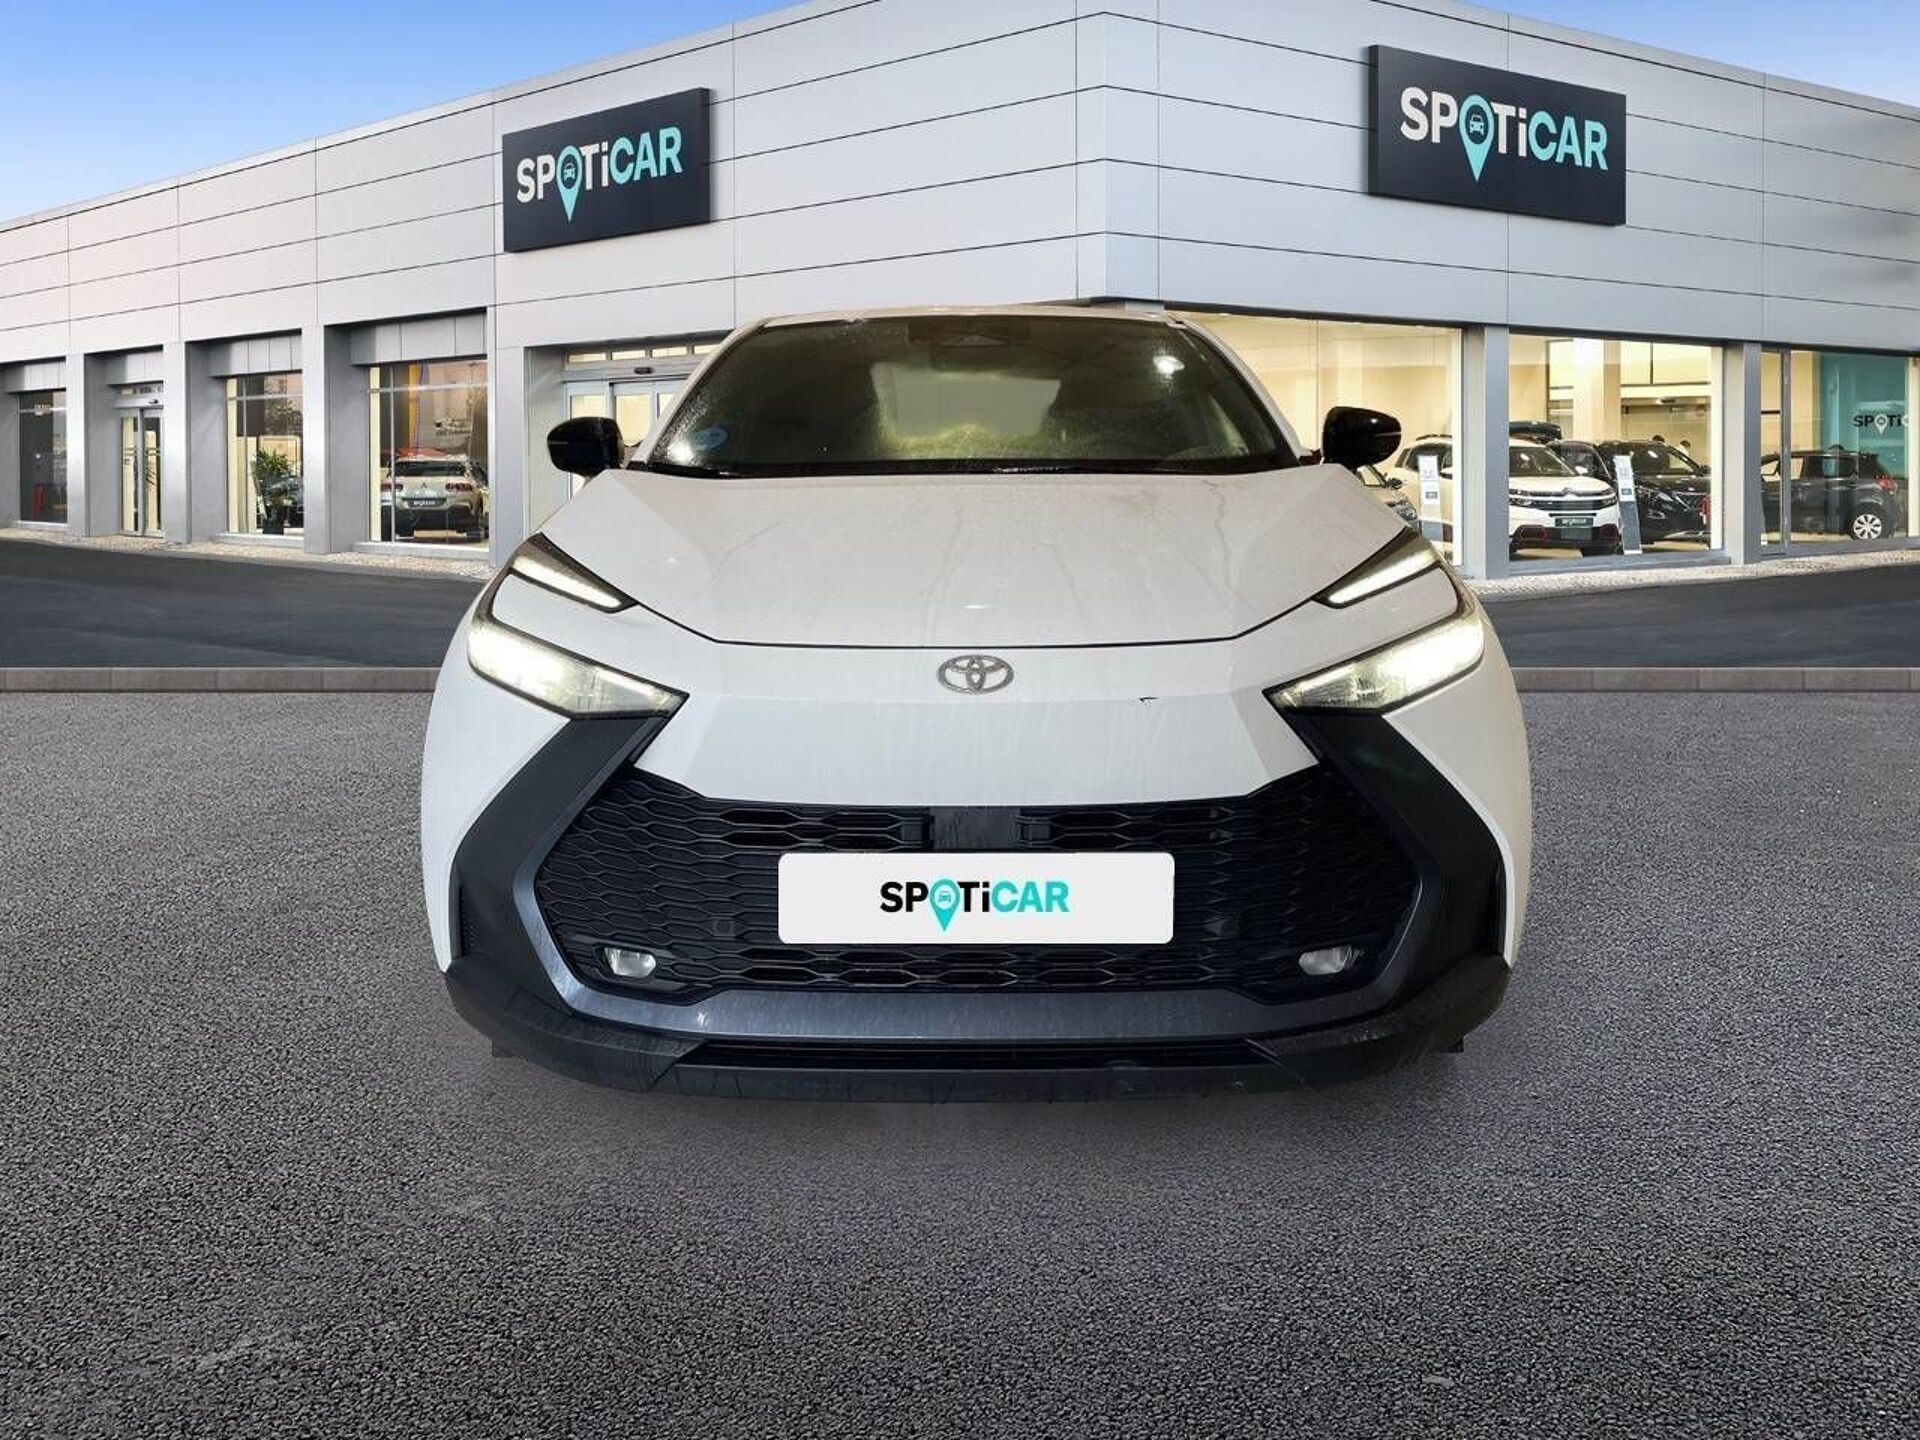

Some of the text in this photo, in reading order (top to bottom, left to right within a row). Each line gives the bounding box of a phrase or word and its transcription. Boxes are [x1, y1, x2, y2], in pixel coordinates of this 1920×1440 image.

[516, 126, 683, 222] SPOTiCAR
[1400, 86, 1608, 182] SPOTiCAR
[880, 878, 1070, 931] SPOTiCAR
